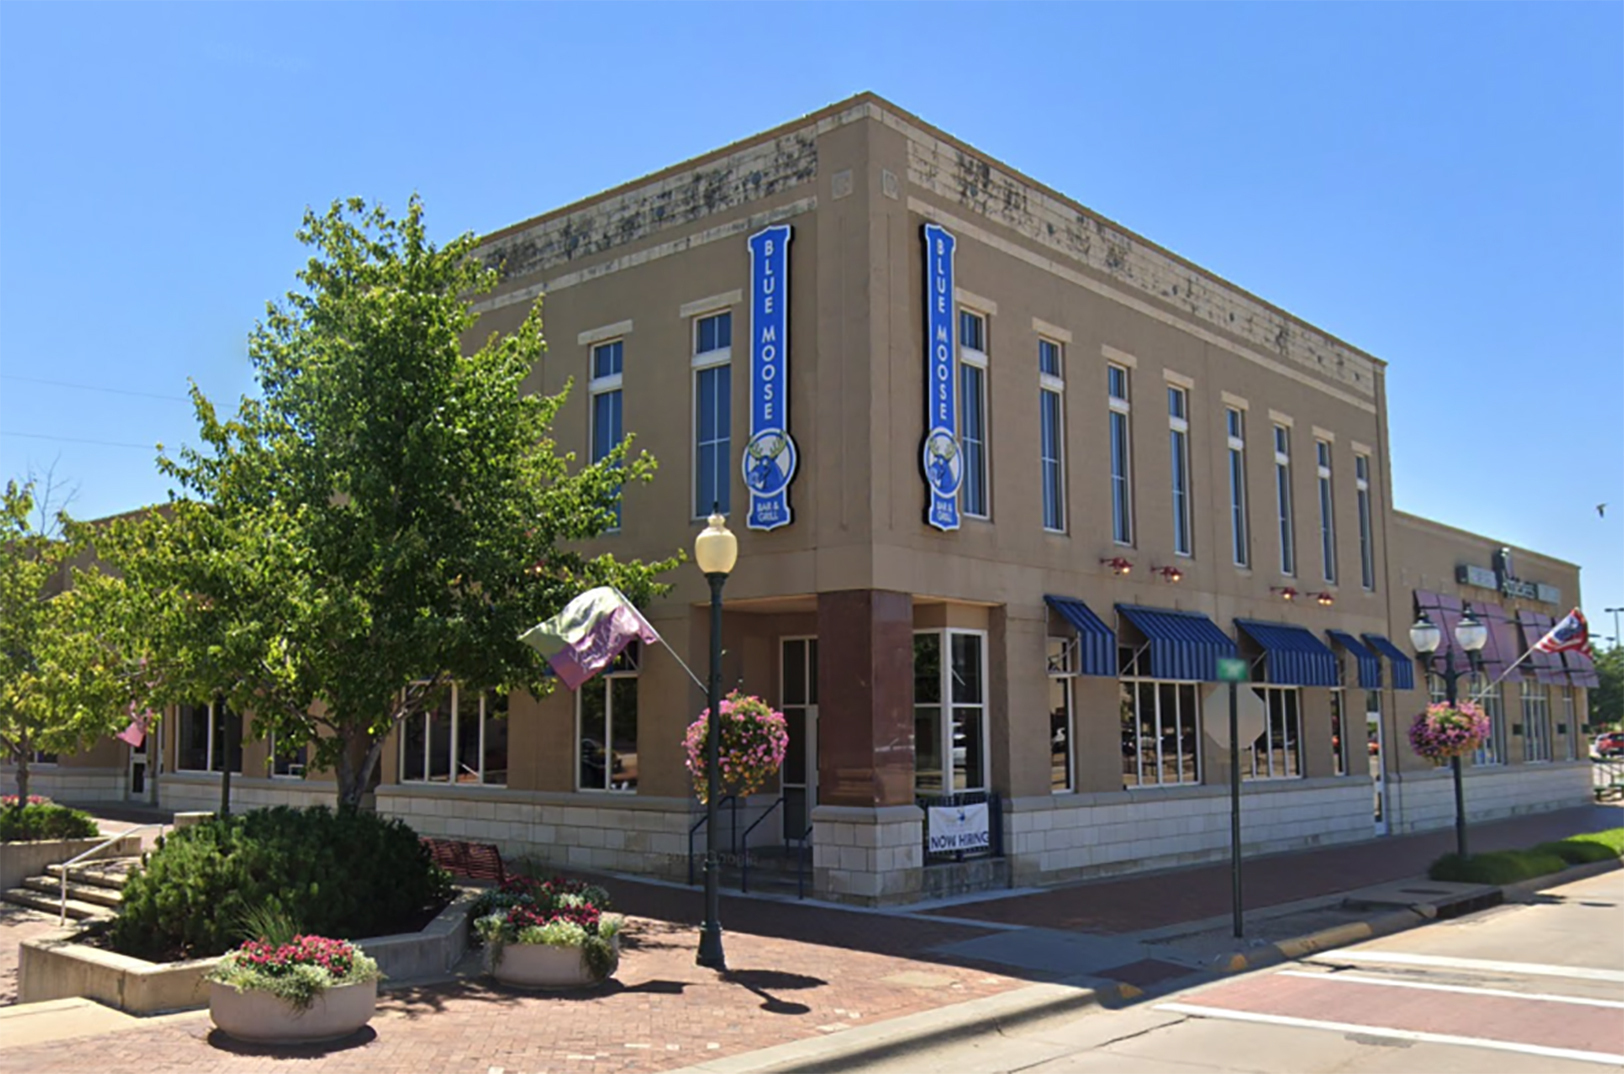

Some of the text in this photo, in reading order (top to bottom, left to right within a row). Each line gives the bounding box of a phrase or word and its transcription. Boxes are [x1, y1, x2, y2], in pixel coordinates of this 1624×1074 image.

[761, 239, 776, 420] BLUE MOOSE
[936, 238, 948, 420] BLUE MOOSE
[757, 502, 771, 512] BAR
[757, 511, 778, 522] GRILL
[931, 831, 989, 849] NOW HIRING
